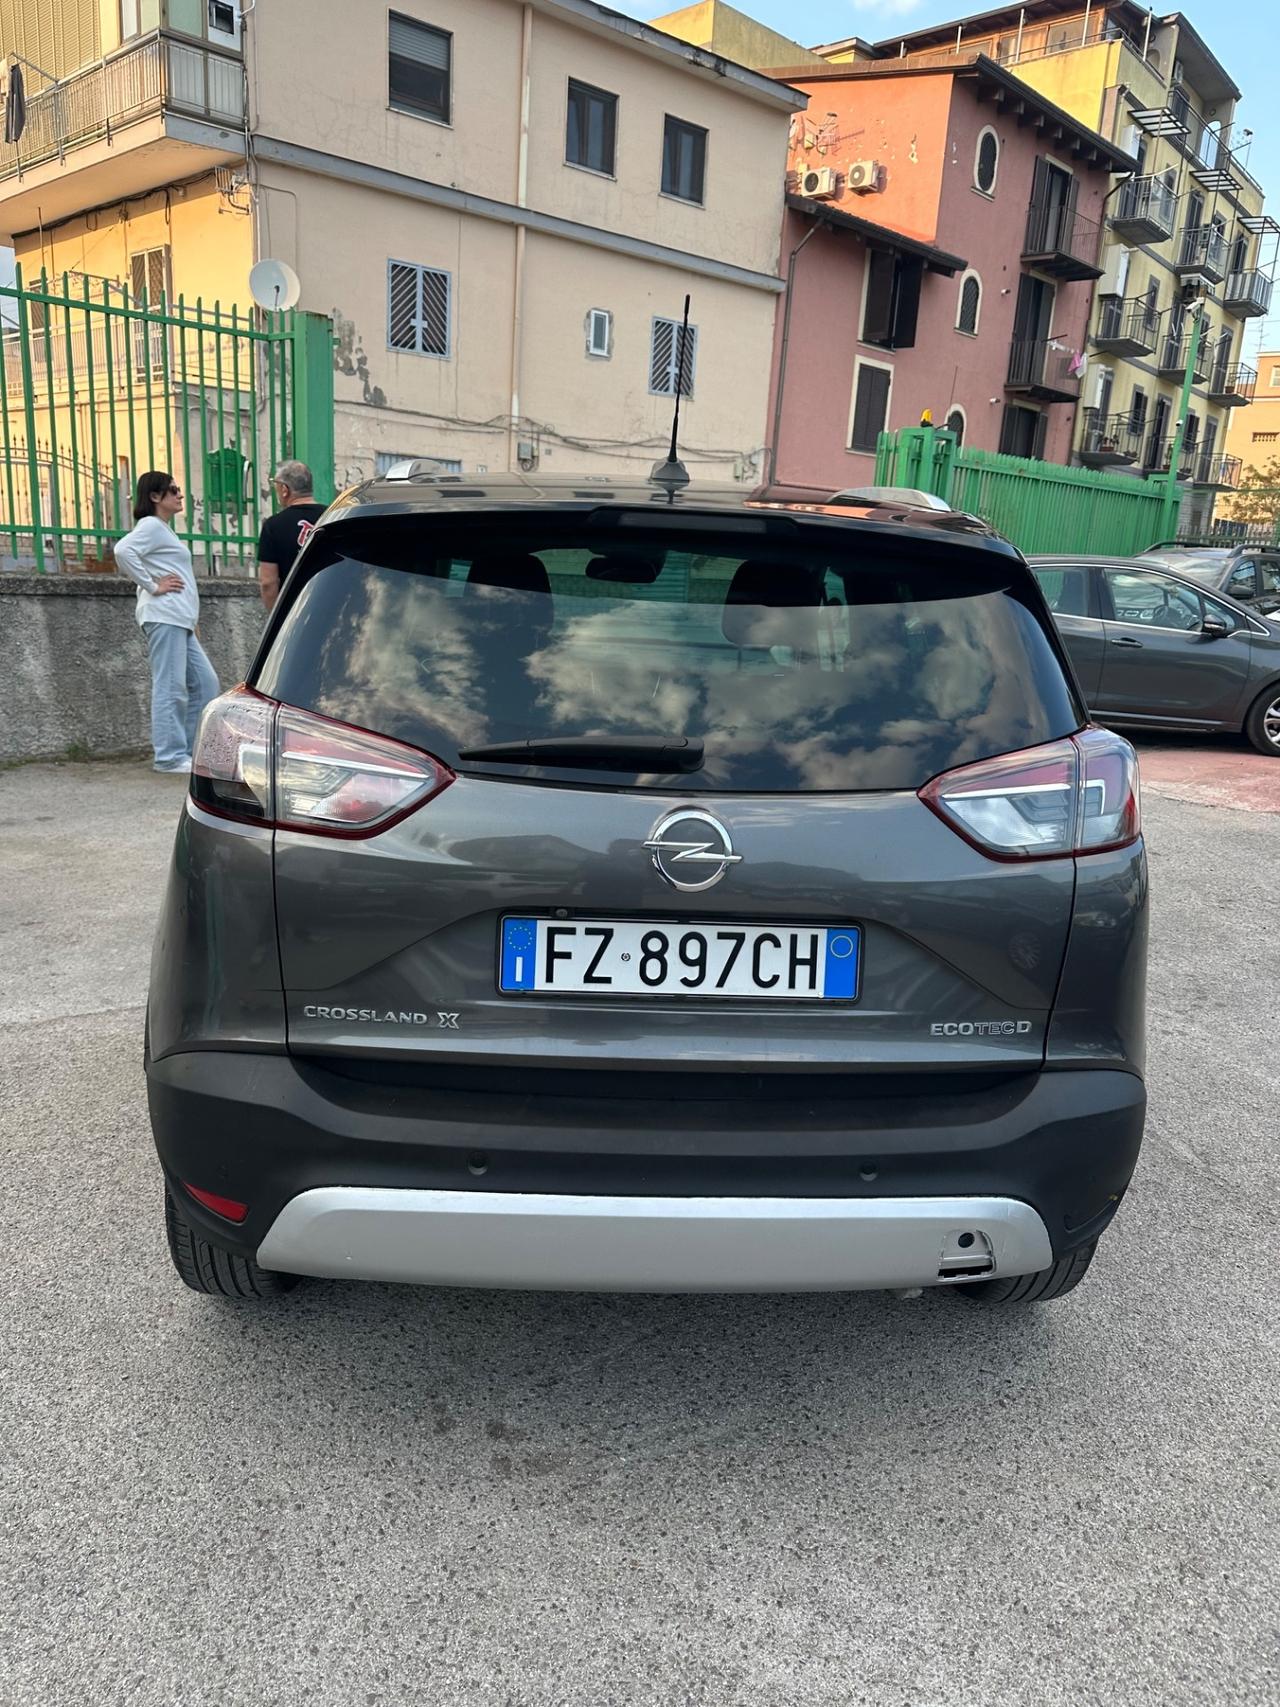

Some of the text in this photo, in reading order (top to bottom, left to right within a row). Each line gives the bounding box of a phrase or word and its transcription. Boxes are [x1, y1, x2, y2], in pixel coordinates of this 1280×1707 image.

[545, 926, 819, 990] FZ 897CH
[303, 1005, 460, 1029] CROSSLAND X
